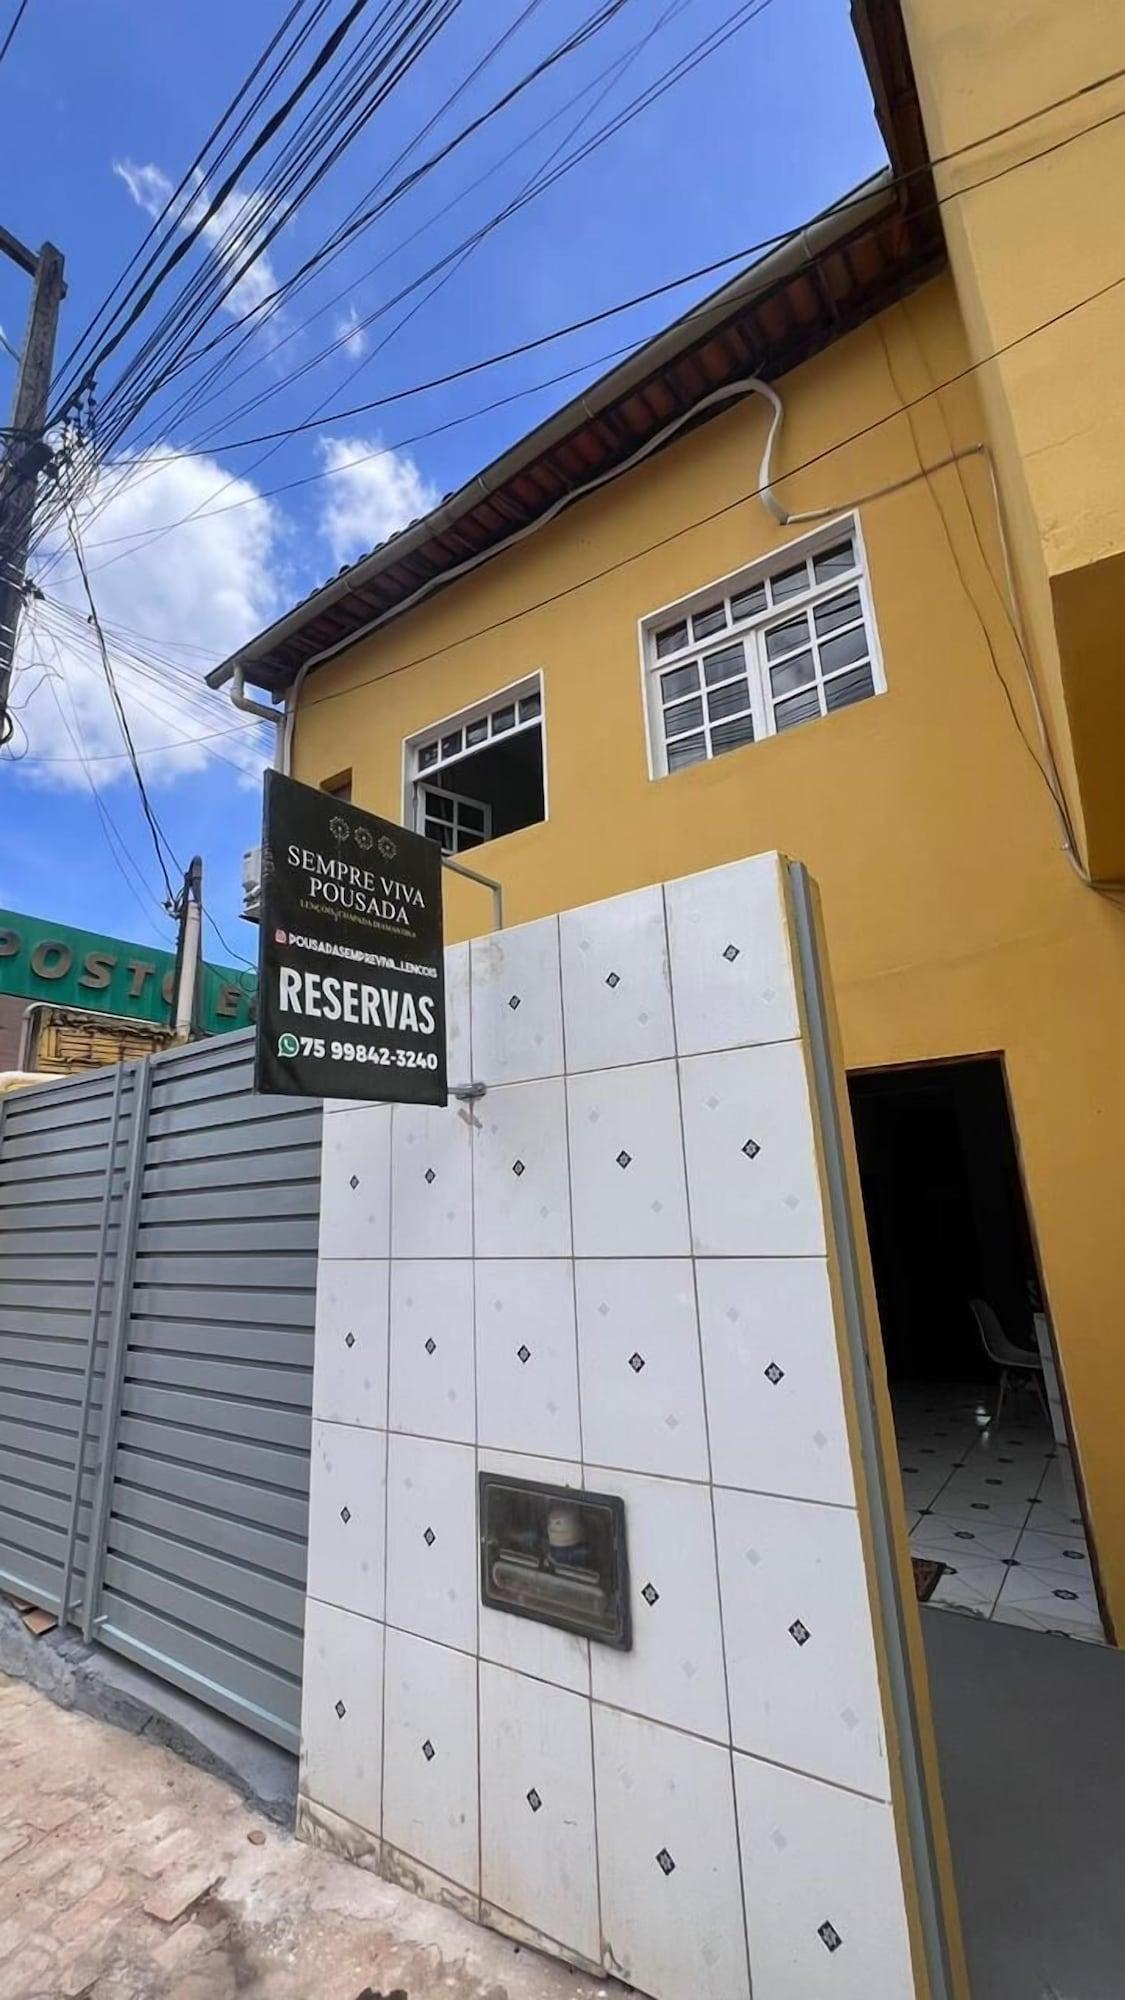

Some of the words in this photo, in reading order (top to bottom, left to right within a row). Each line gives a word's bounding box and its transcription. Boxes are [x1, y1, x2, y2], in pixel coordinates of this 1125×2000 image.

[288, 845, 376, 891] SEMPRE
[380, 876, 426, 908] VIVA
[310, 876, 410, 926] POUSADA
[279, 966, 436, 1035] RESERVAS
[301, 1036, 326, 1057] 75
[330, 1041, 438, 1071] 99842-3240
